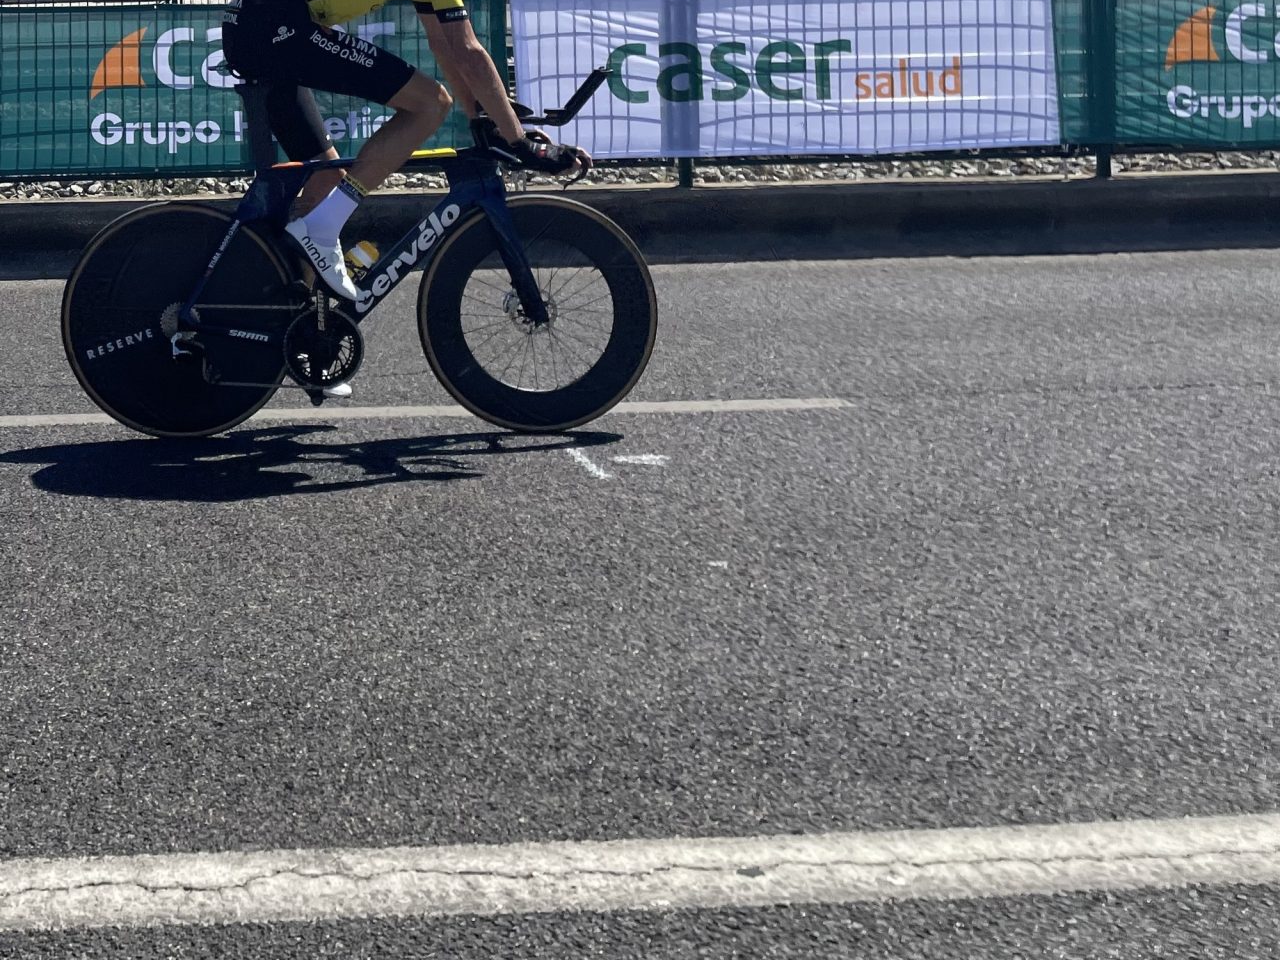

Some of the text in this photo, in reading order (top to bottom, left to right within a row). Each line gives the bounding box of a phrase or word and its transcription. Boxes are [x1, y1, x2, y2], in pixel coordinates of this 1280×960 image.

[607, 39, 961, 103] caser salud
[91, 113, 220, 153] Grupo
[301, 235, 331, 273] nimbl
[355, 204, 460, 313] cervélo
[86, 328, 153, 360] RESERVE
[229, 329, 269, 342] SRAM
